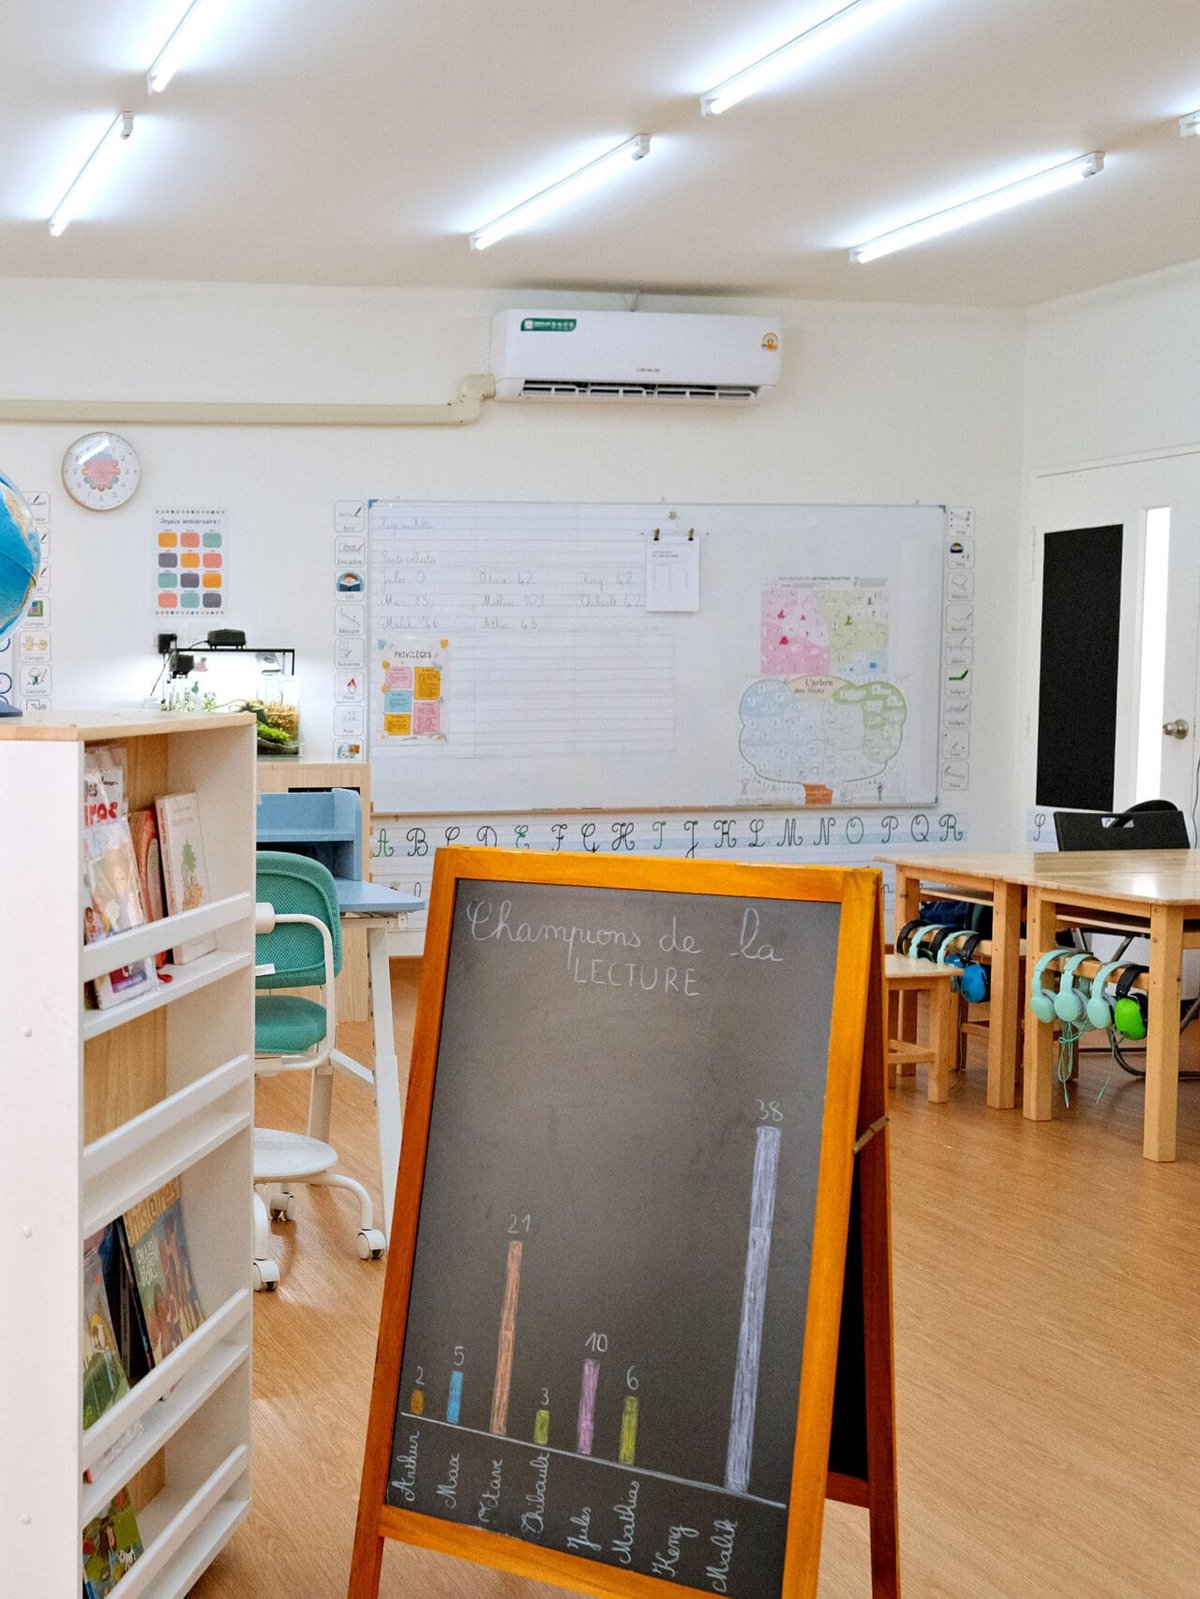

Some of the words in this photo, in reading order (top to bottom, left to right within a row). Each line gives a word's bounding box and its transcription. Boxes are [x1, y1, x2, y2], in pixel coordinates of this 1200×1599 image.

[160, 518, 180, 526] Joyeux
[372, 828, 394, 858] A
[406, 827, 428, 856] B
[476, 825, 498, 847] D
[514, 824, 530, 849] E
[551, 823, 568, 851] F
[581, 823, 600, 853] G
[611, 822, 635, 851] H
[713, 819, 737, 848] K
[748, 819, 765, 848] L
[777, 818, 803, 847] M
[813, 817, 836, 846] N
[845, 816, 864, 844] O
[881, 815, 899, 844] P
[910, 814, 930, 842] Q
[939, 814, 963, 842] R
[466, 899, 642, 969] Champions
[658, 915, 702, 955] de
[729, 907, 784, 963] la
[574, 957, 700, 996] LECTURE
[755, 1099, 784, 1122] 38
[507, 1214, 531, 1233] 21
[452, 1346, 465, 1366] 5
[584, 1331, 609, 1353] 10
[413, 1365, 426, 1385] 2
[625, 1364, 640, 1390] 6
[540, 1386, 551, 1406] 3
[391, 1430, 420, 1502] Arthur
[435, 1452, 460, 1509] Max
[521, 1452, 550, 1534] Thibault
[566, 1506, 602, 1551] Jules
[611, 1480, 640, 1565] Mathias
[651, 1524, 700, 1578] Keng
[705, 1519, 738, 1593] Malik
